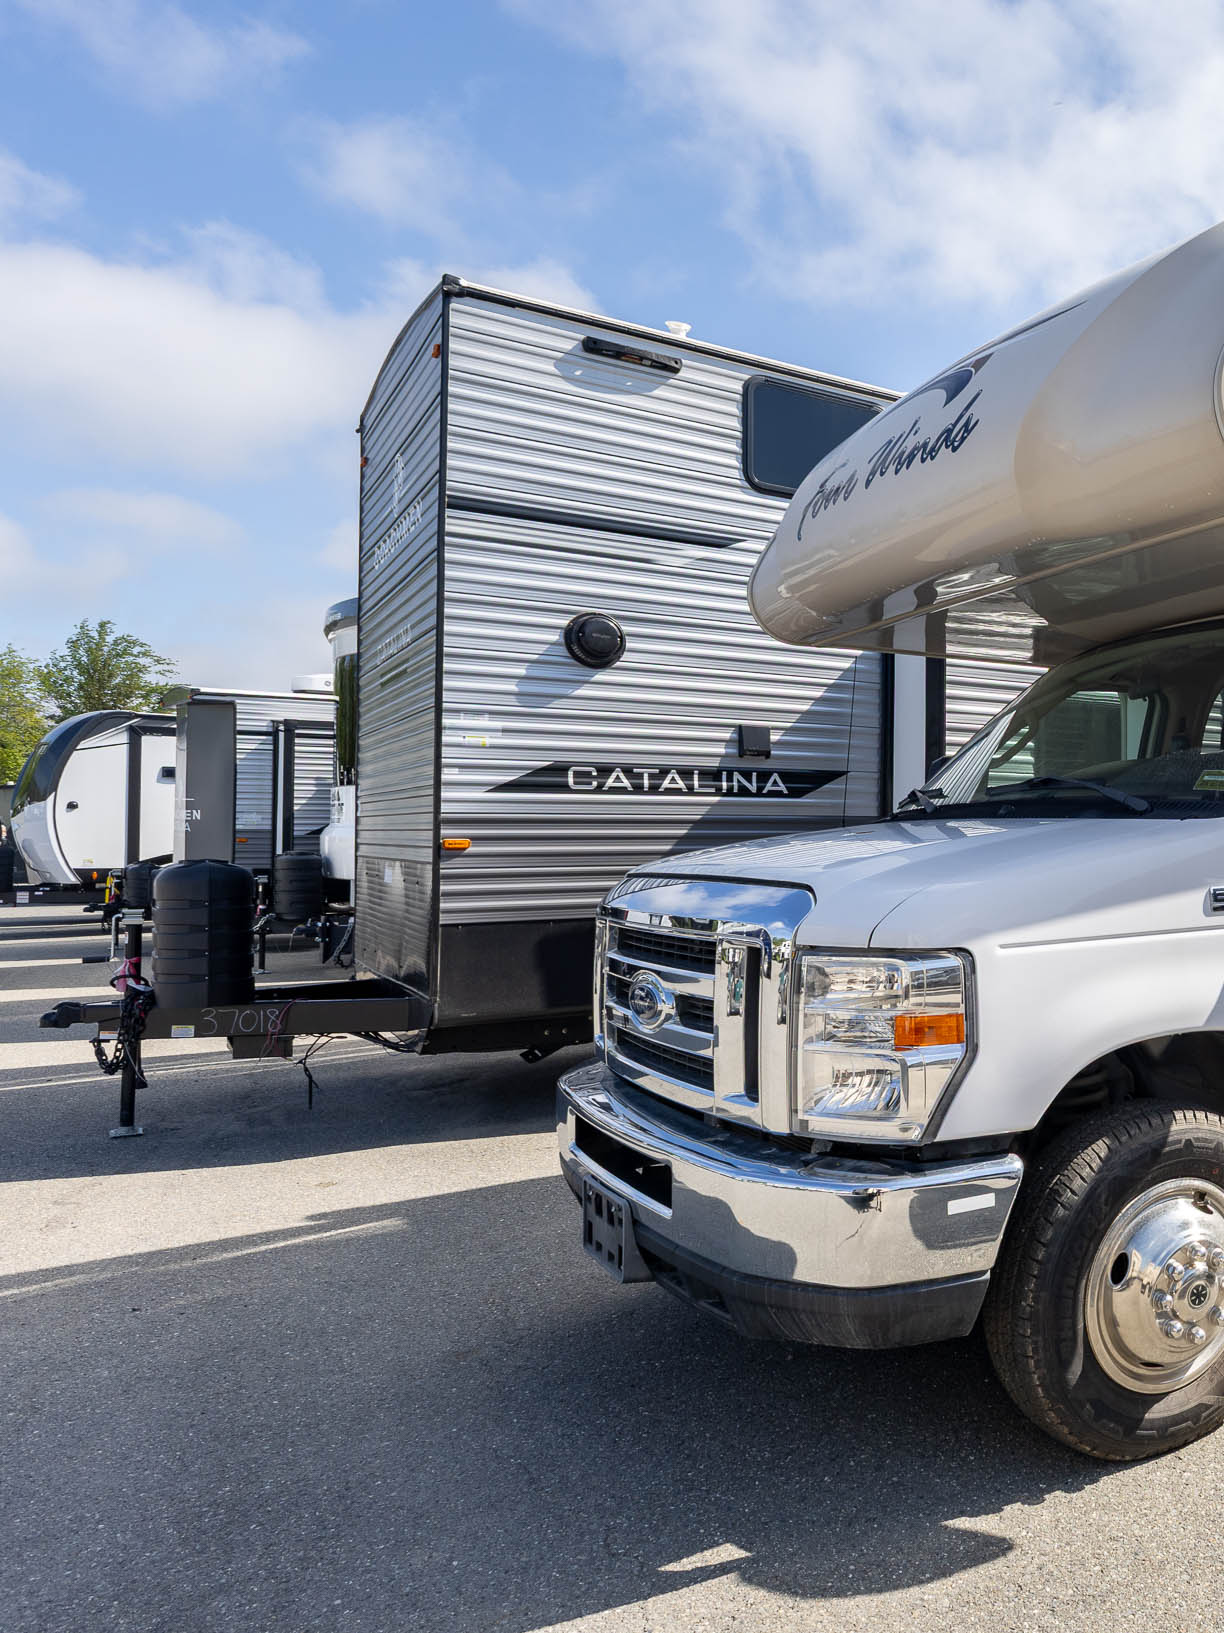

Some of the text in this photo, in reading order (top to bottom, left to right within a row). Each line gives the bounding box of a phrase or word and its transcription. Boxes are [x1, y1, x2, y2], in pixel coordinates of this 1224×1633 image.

[798, 389, 983, 541] Four Winds
[567, 766, 788, 794] CATALINA
[201, 1007, 280, 1035] 37018
